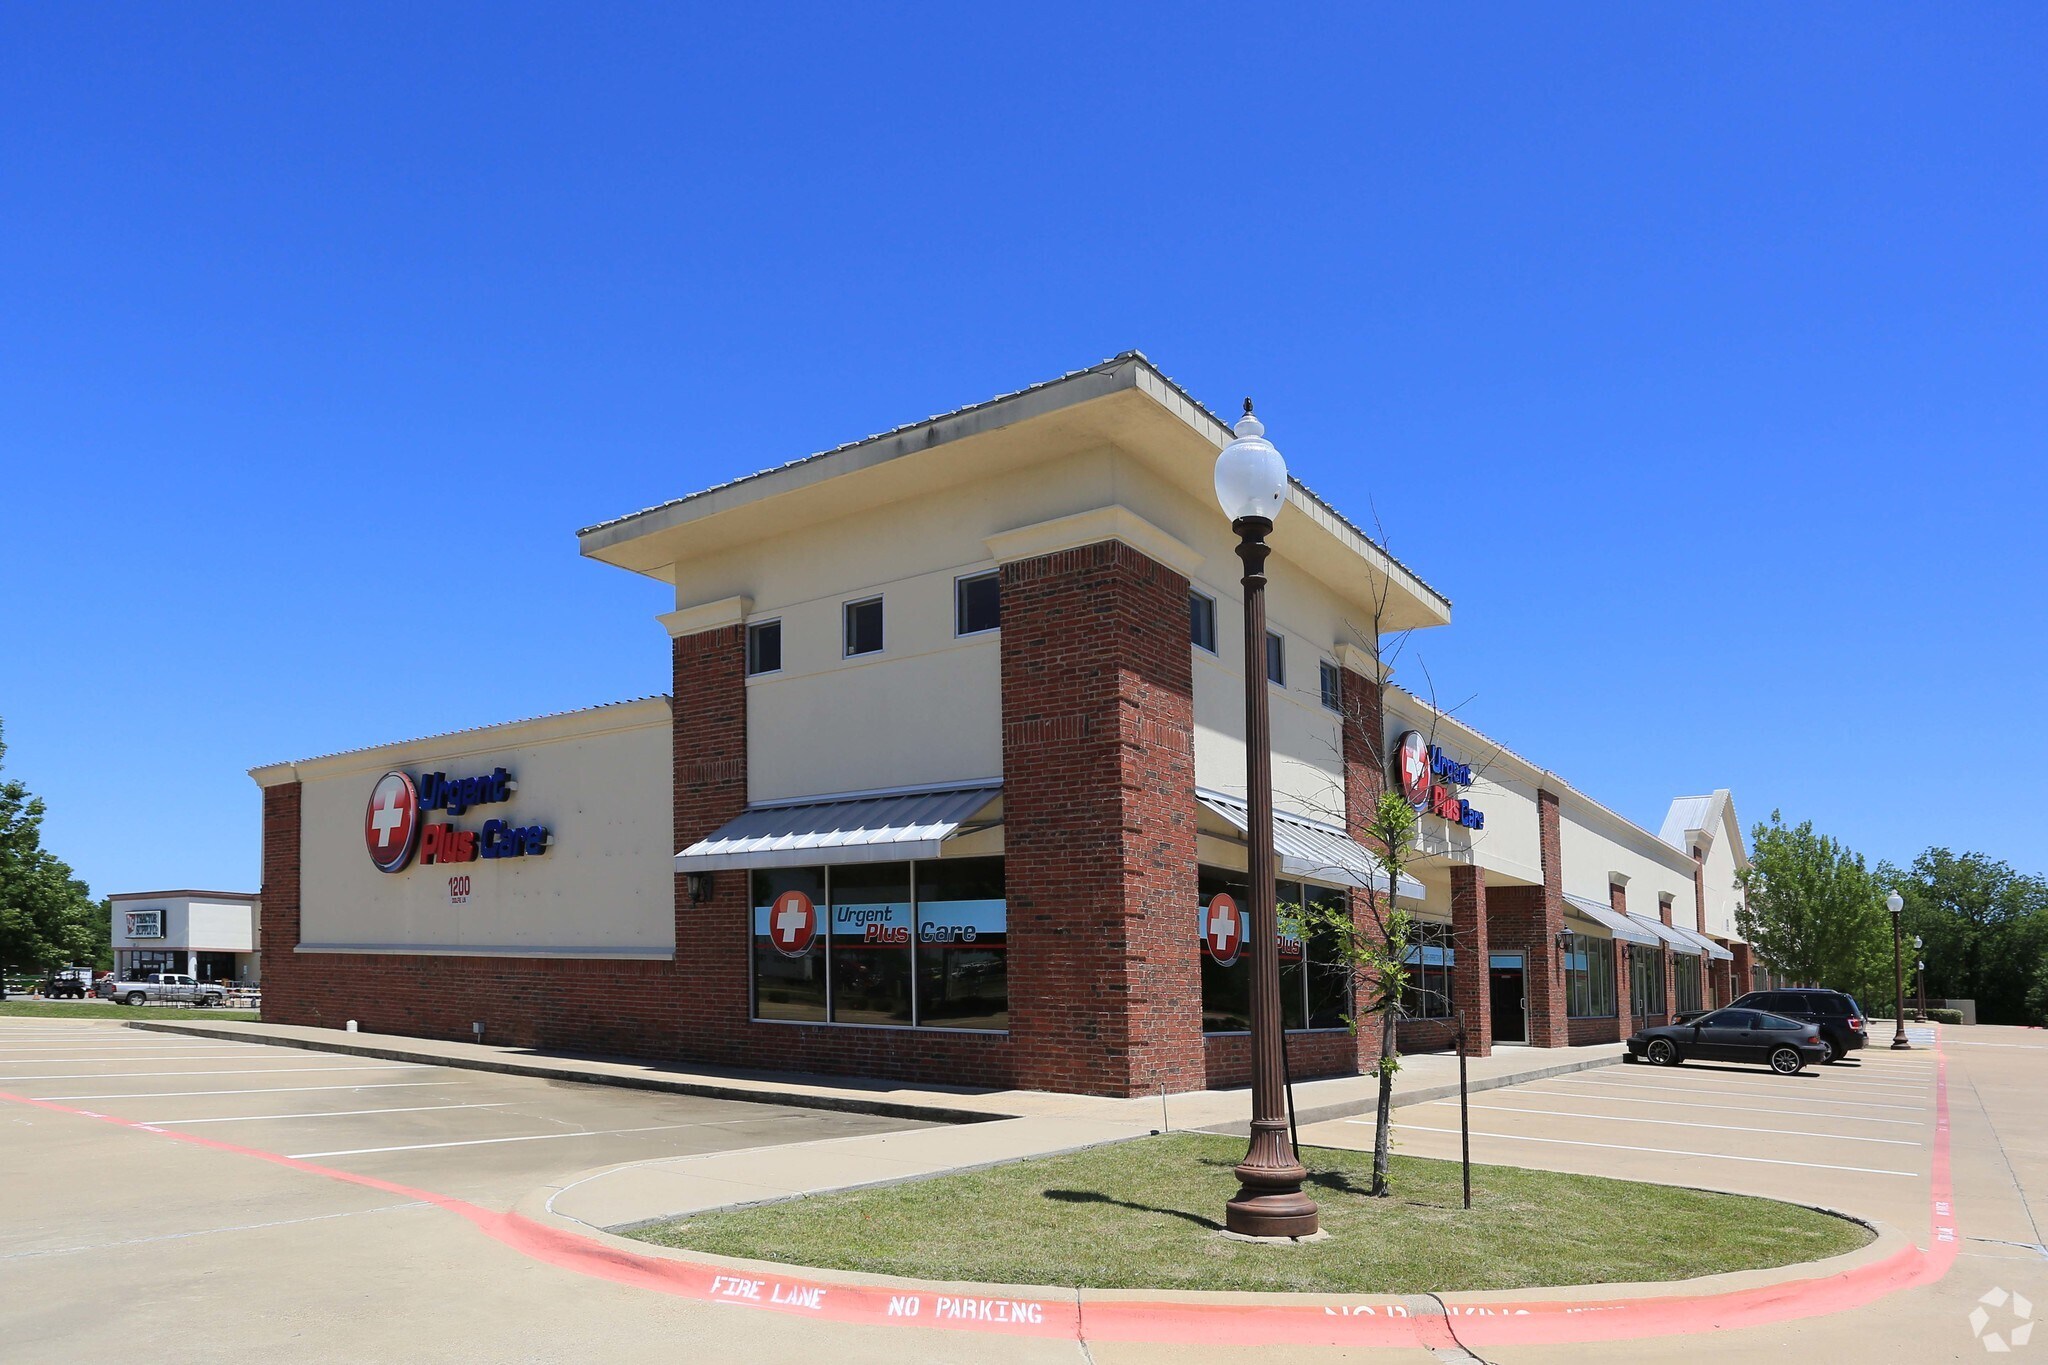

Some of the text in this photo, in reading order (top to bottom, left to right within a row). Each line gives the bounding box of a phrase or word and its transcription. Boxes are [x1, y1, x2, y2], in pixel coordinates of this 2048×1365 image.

[1430, 745, 1472, 786] Urgent
[420, 767, 511, 816] Urgent
[1432, 785, 1484, 830] Plus Care
[420, 819, 547, 864] Plus Care
[448, 875, 471, 896] 1200
[837, 905, 892, 927] Urgent
[864, 922, 977, 943] Plus Care
[709, 1275, 826, 1310] FIRE LANE
[887, 1296, 1044, 1324] NO PARKING
